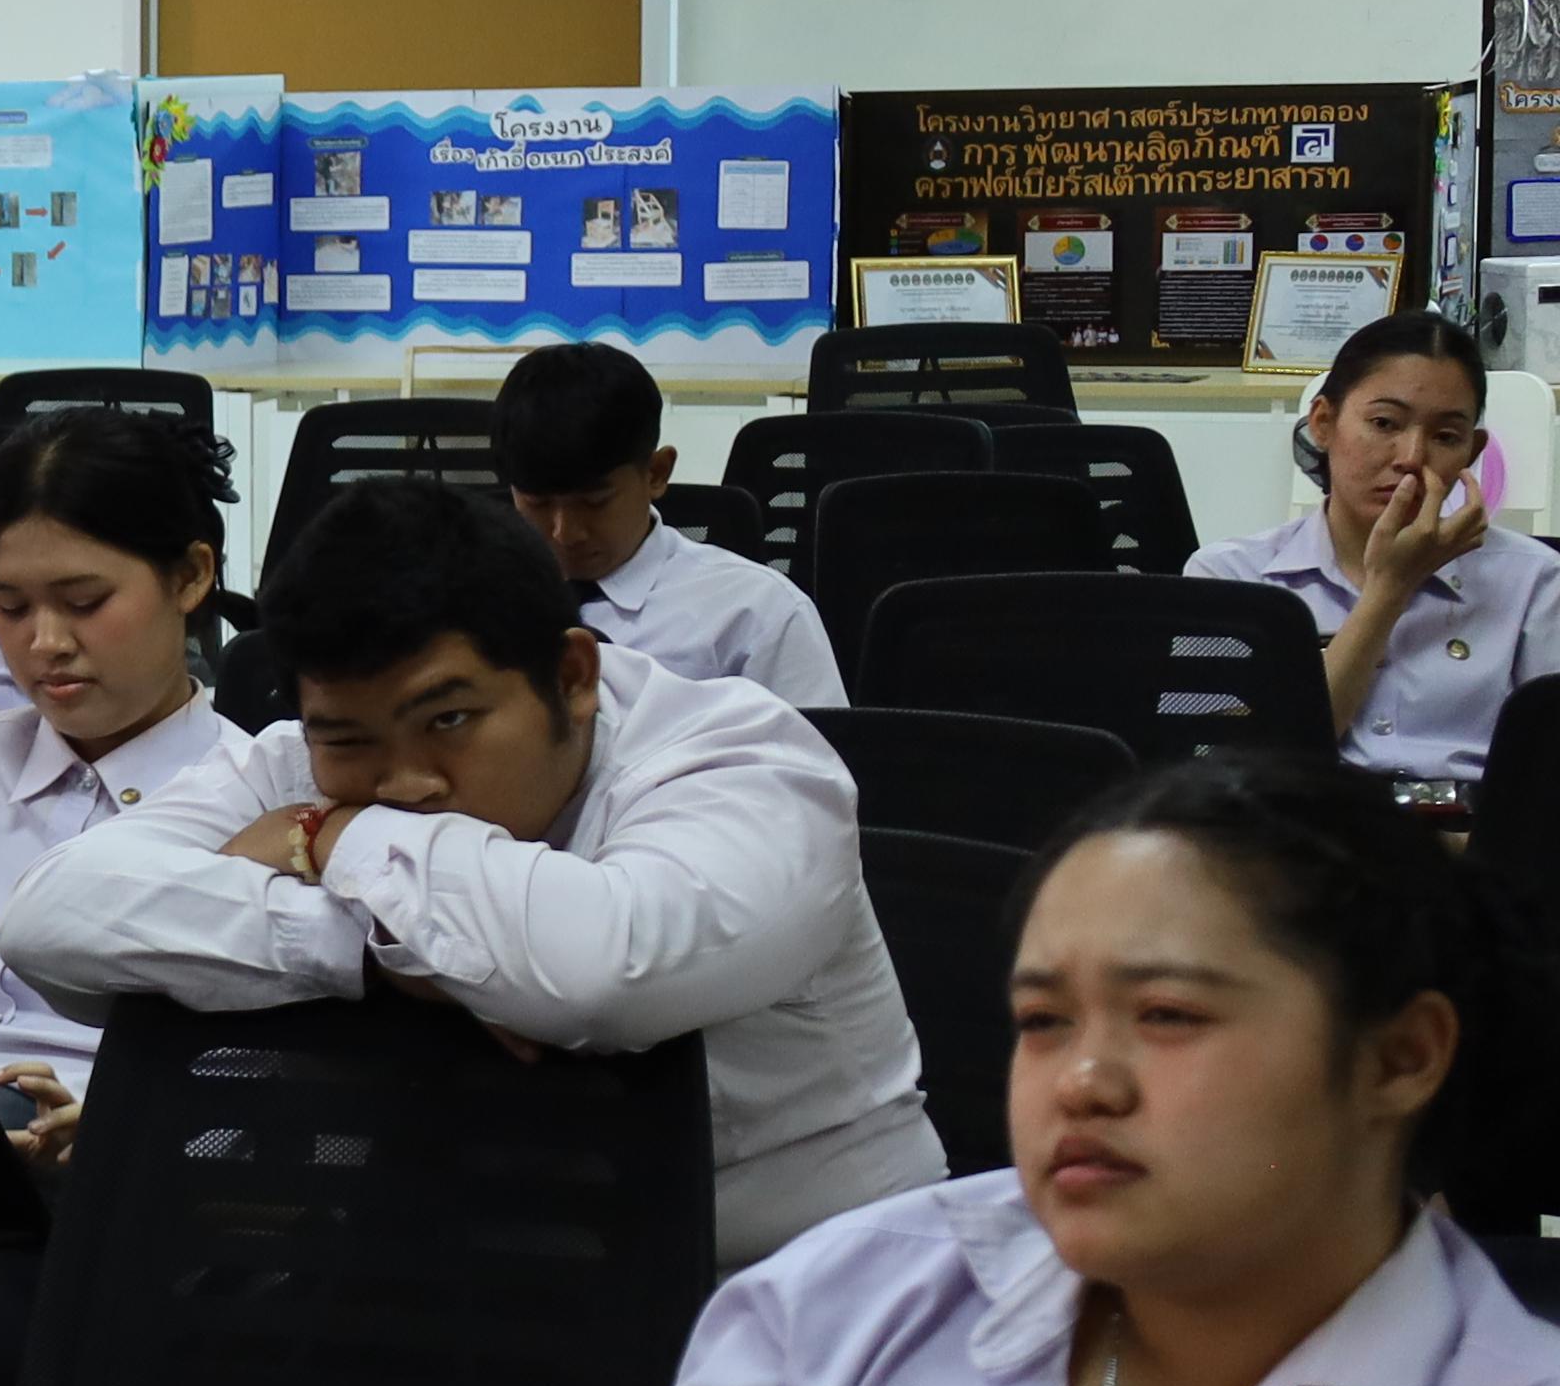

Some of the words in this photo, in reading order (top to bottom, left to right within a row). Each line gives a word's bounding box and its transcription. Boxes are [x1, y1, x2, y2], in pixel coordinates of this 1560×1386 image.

[1504, 85, 1560, 108] โครง
[494, 112, 602, 139] โครงงาน
